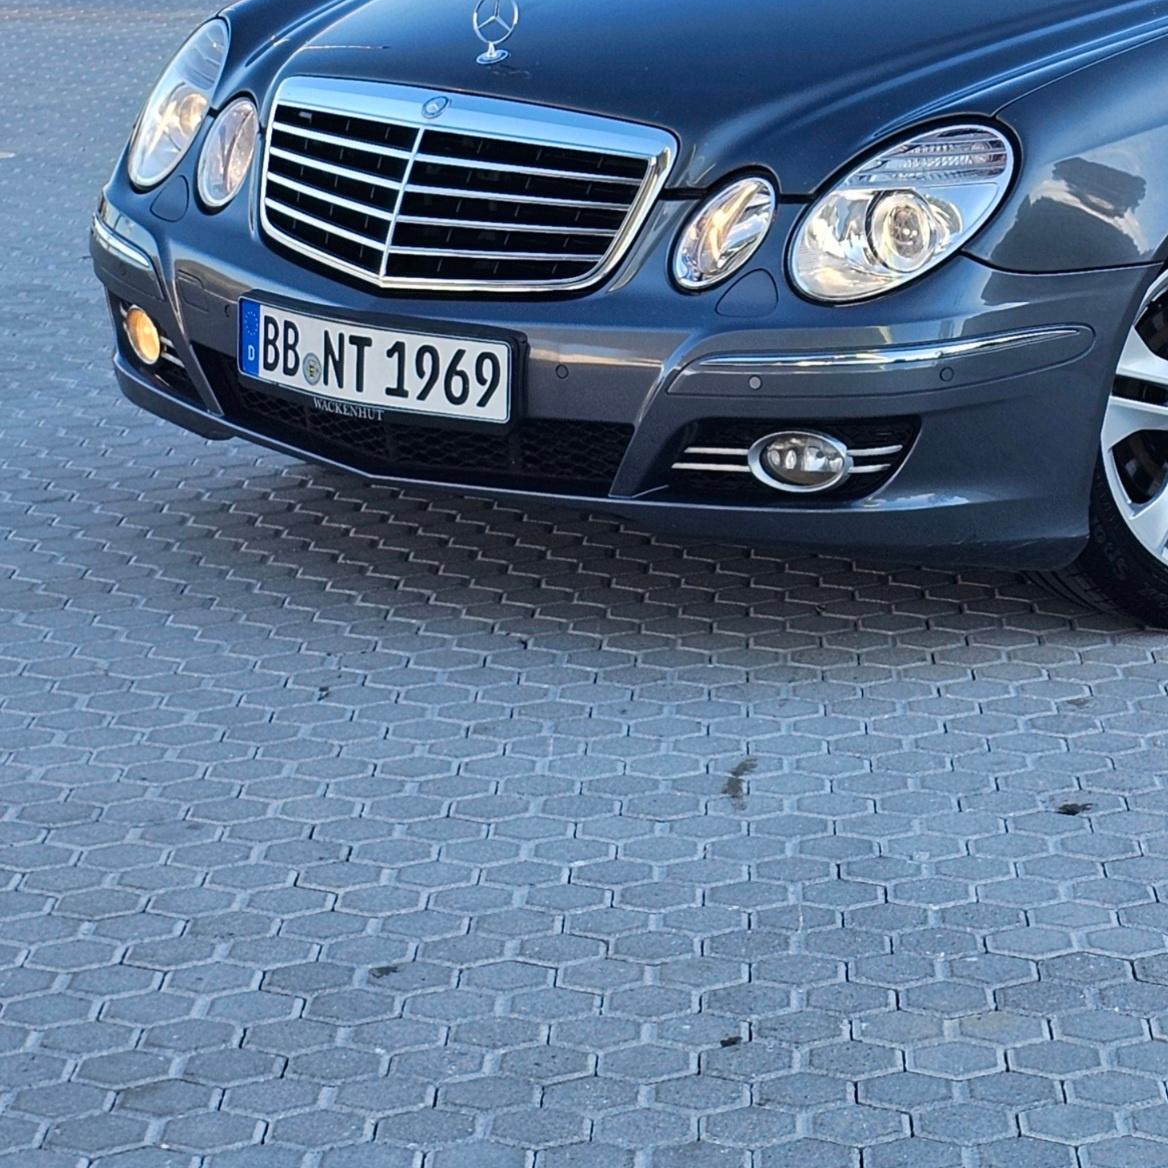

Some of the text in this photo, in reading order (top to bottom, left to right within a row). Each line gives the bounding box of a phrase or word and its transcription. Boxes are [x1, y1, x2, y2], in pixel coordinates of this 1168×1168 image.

[247, 344, 256, 361] D
[262, 315, 501, 408] BB NT 1969
[312, 396, 385, 422] WACKENHUT
